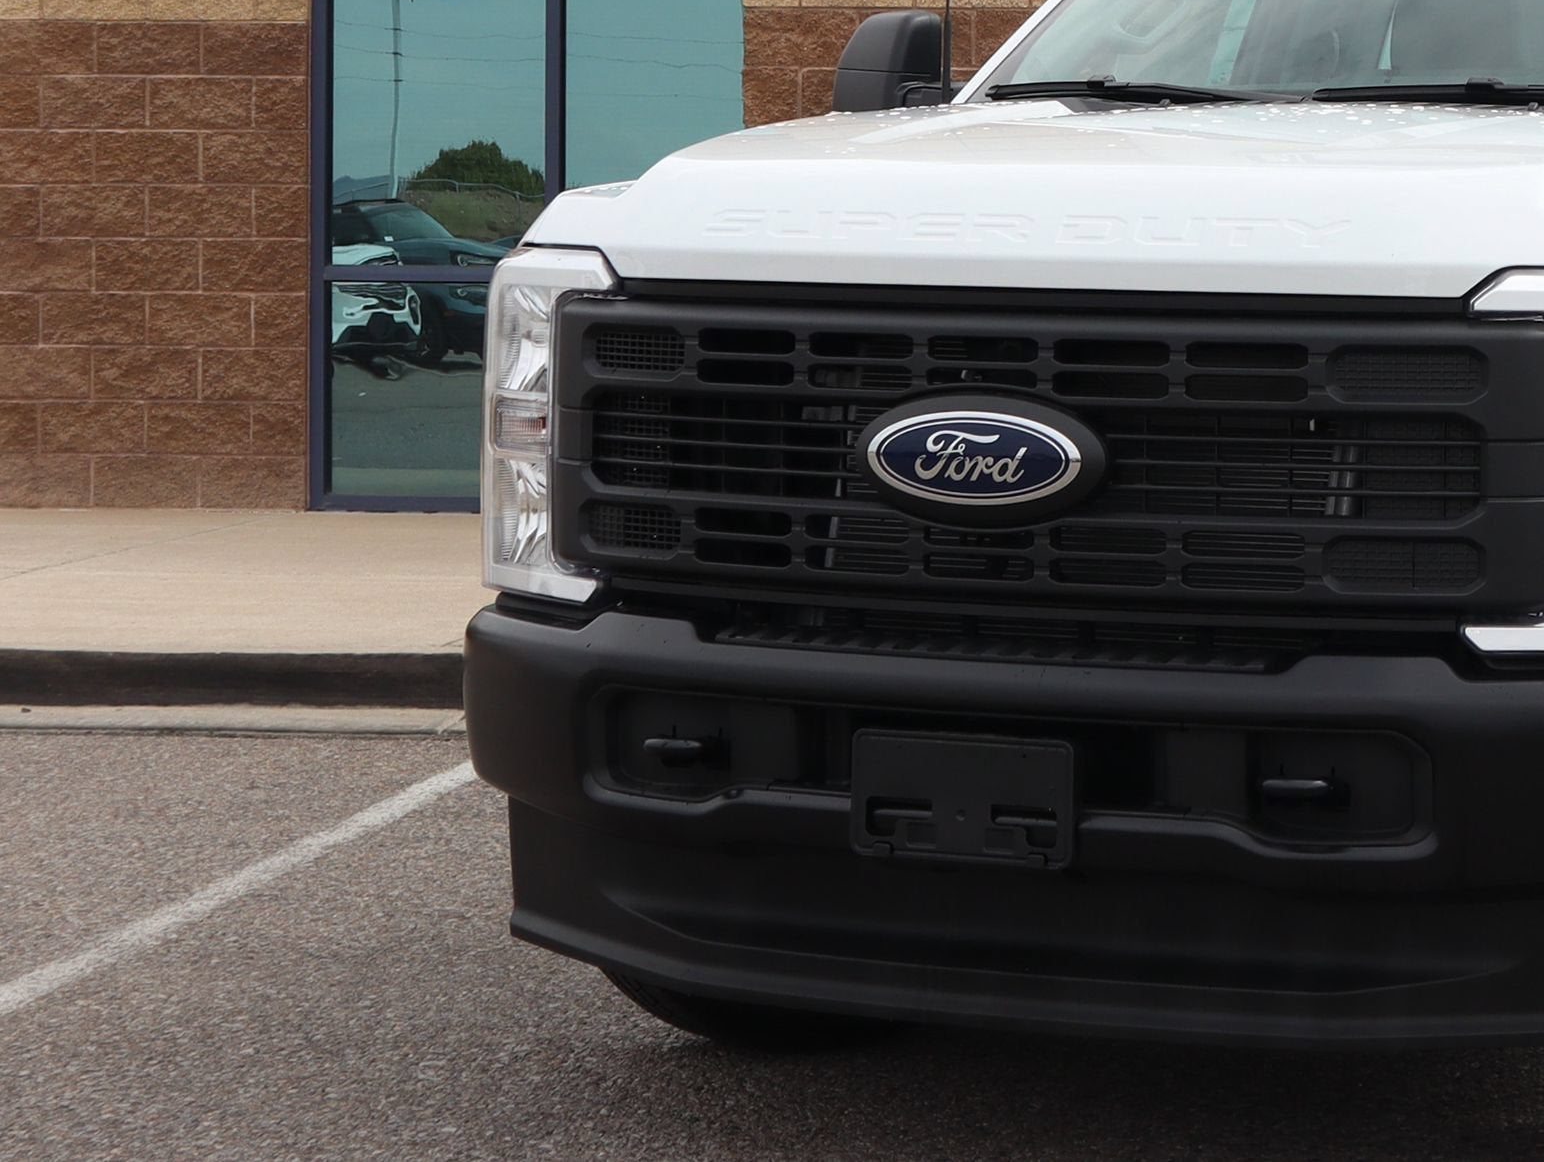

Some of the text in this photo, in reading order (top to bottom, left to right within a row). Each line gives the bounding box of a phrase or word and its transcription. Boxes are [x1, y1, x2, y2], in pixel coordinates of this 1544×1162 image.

[701, 208, 1353, 248] SUPER DUTY
[914, 429, 1028, 484] Ford
